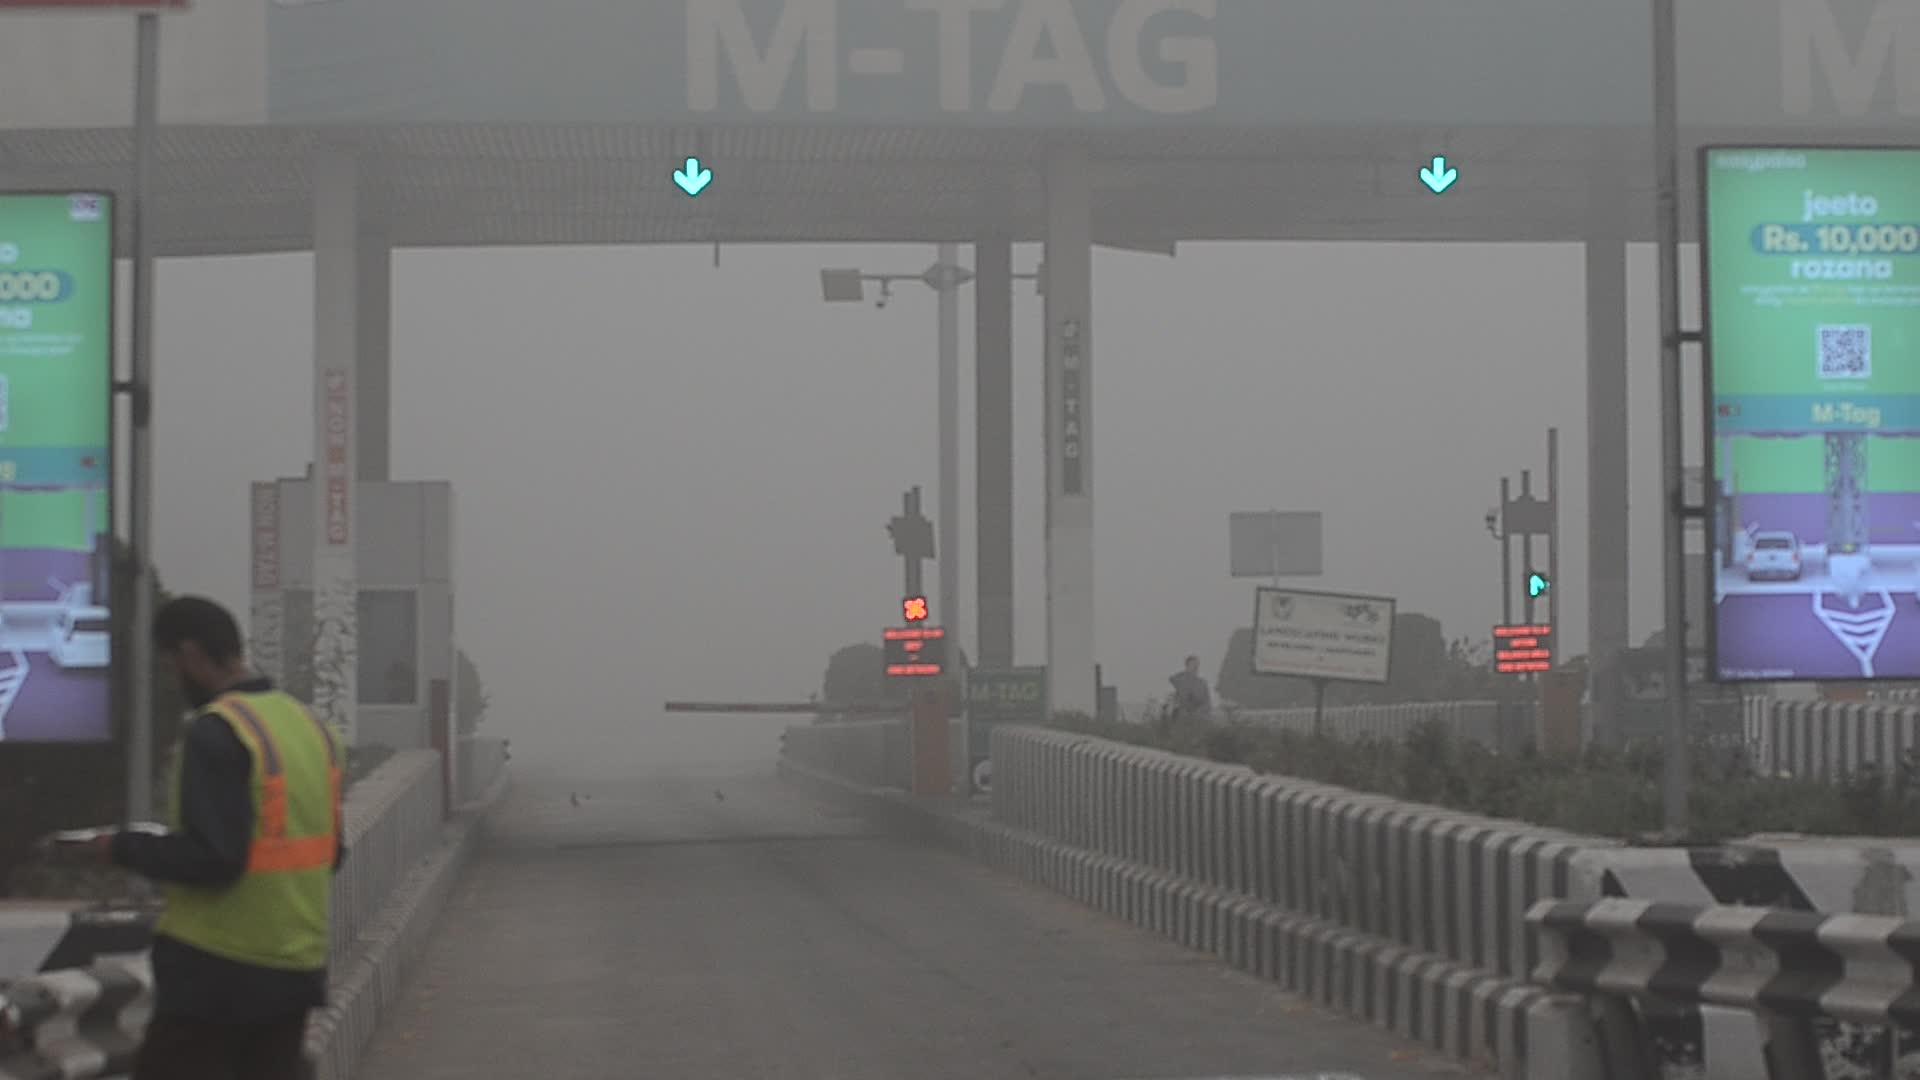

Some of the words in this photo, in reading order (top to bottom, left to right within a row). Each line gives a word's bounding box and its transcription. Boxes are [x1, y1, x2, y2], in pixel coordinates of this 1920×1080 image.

[684, 0, 1218, 112] M-TAG
[1803, 189, 1878, 222] jeeto
[1763, 224, 1809, 250] Rs.
[1816, 225, 1918, 256] 10,000
[1791, 259, 1892, 279] rozana
[1811, 401, 1881, 427] M-Tag
